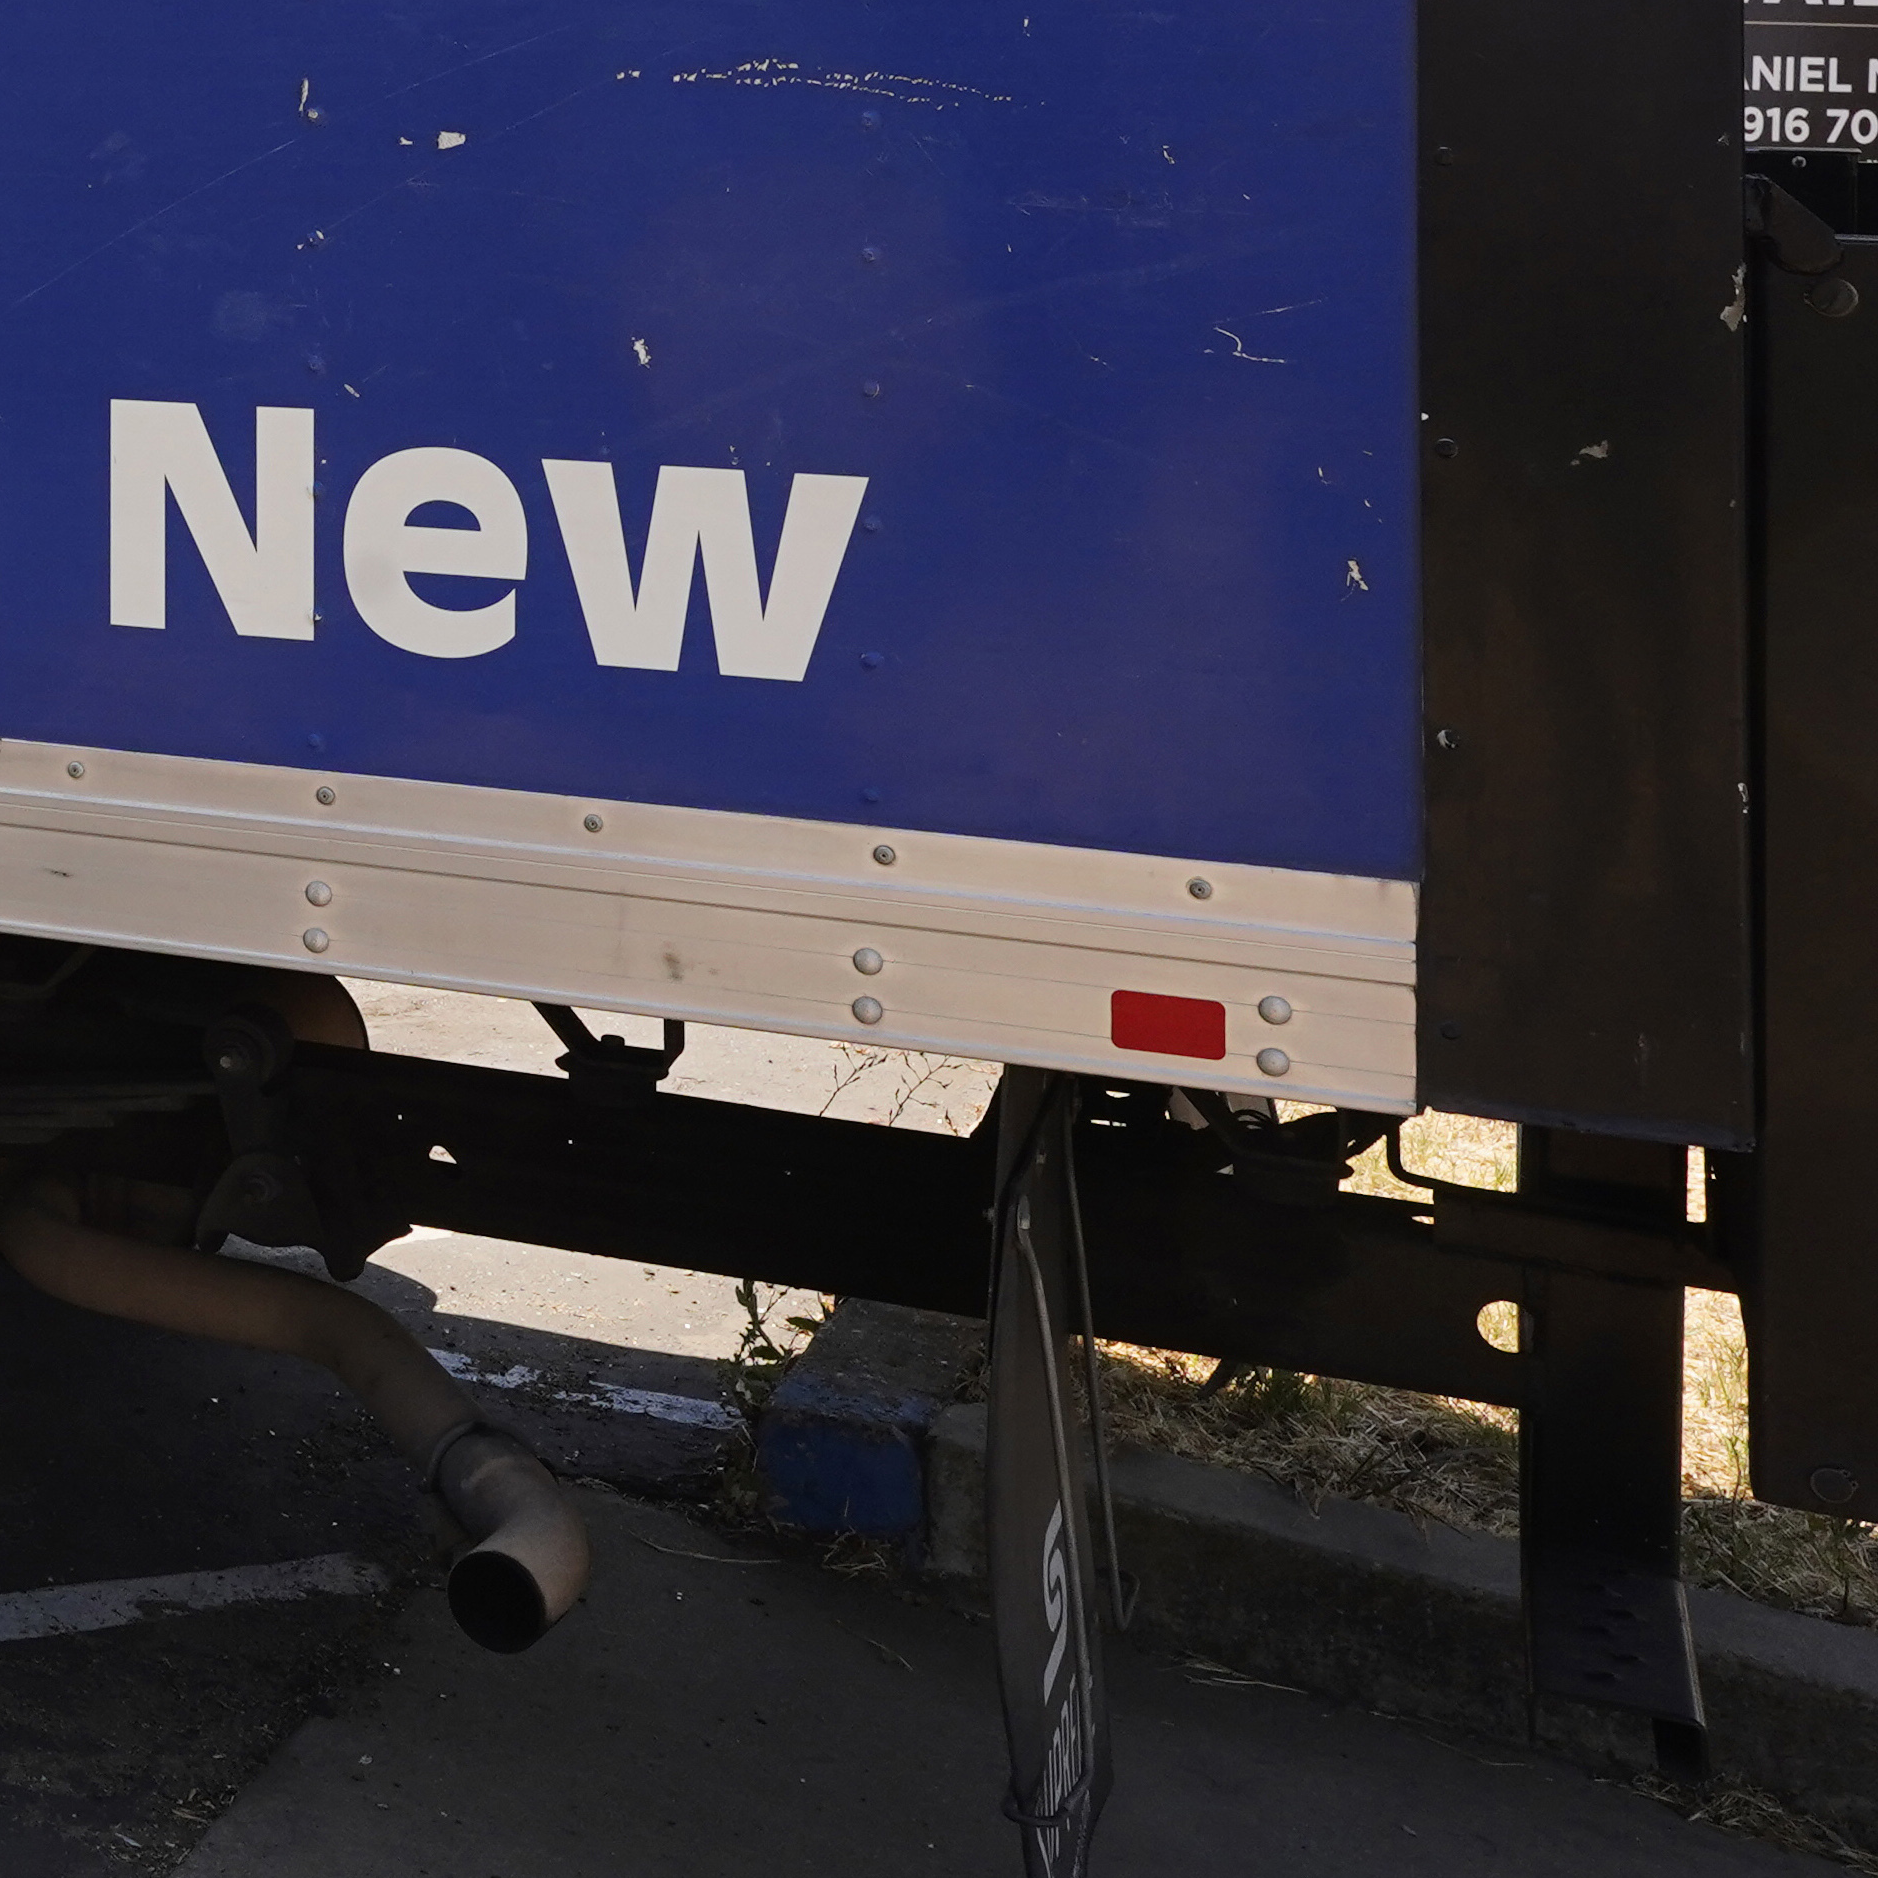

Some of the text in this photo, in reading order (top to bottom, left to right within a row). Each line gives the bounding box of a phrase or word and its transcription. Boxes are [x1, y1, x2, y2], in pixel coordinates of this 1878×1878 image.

[1744, 55, 1853, 93] NIEL
[1744, 106, 1878, 144] 916 70
[110, 398, 869, 682] New
